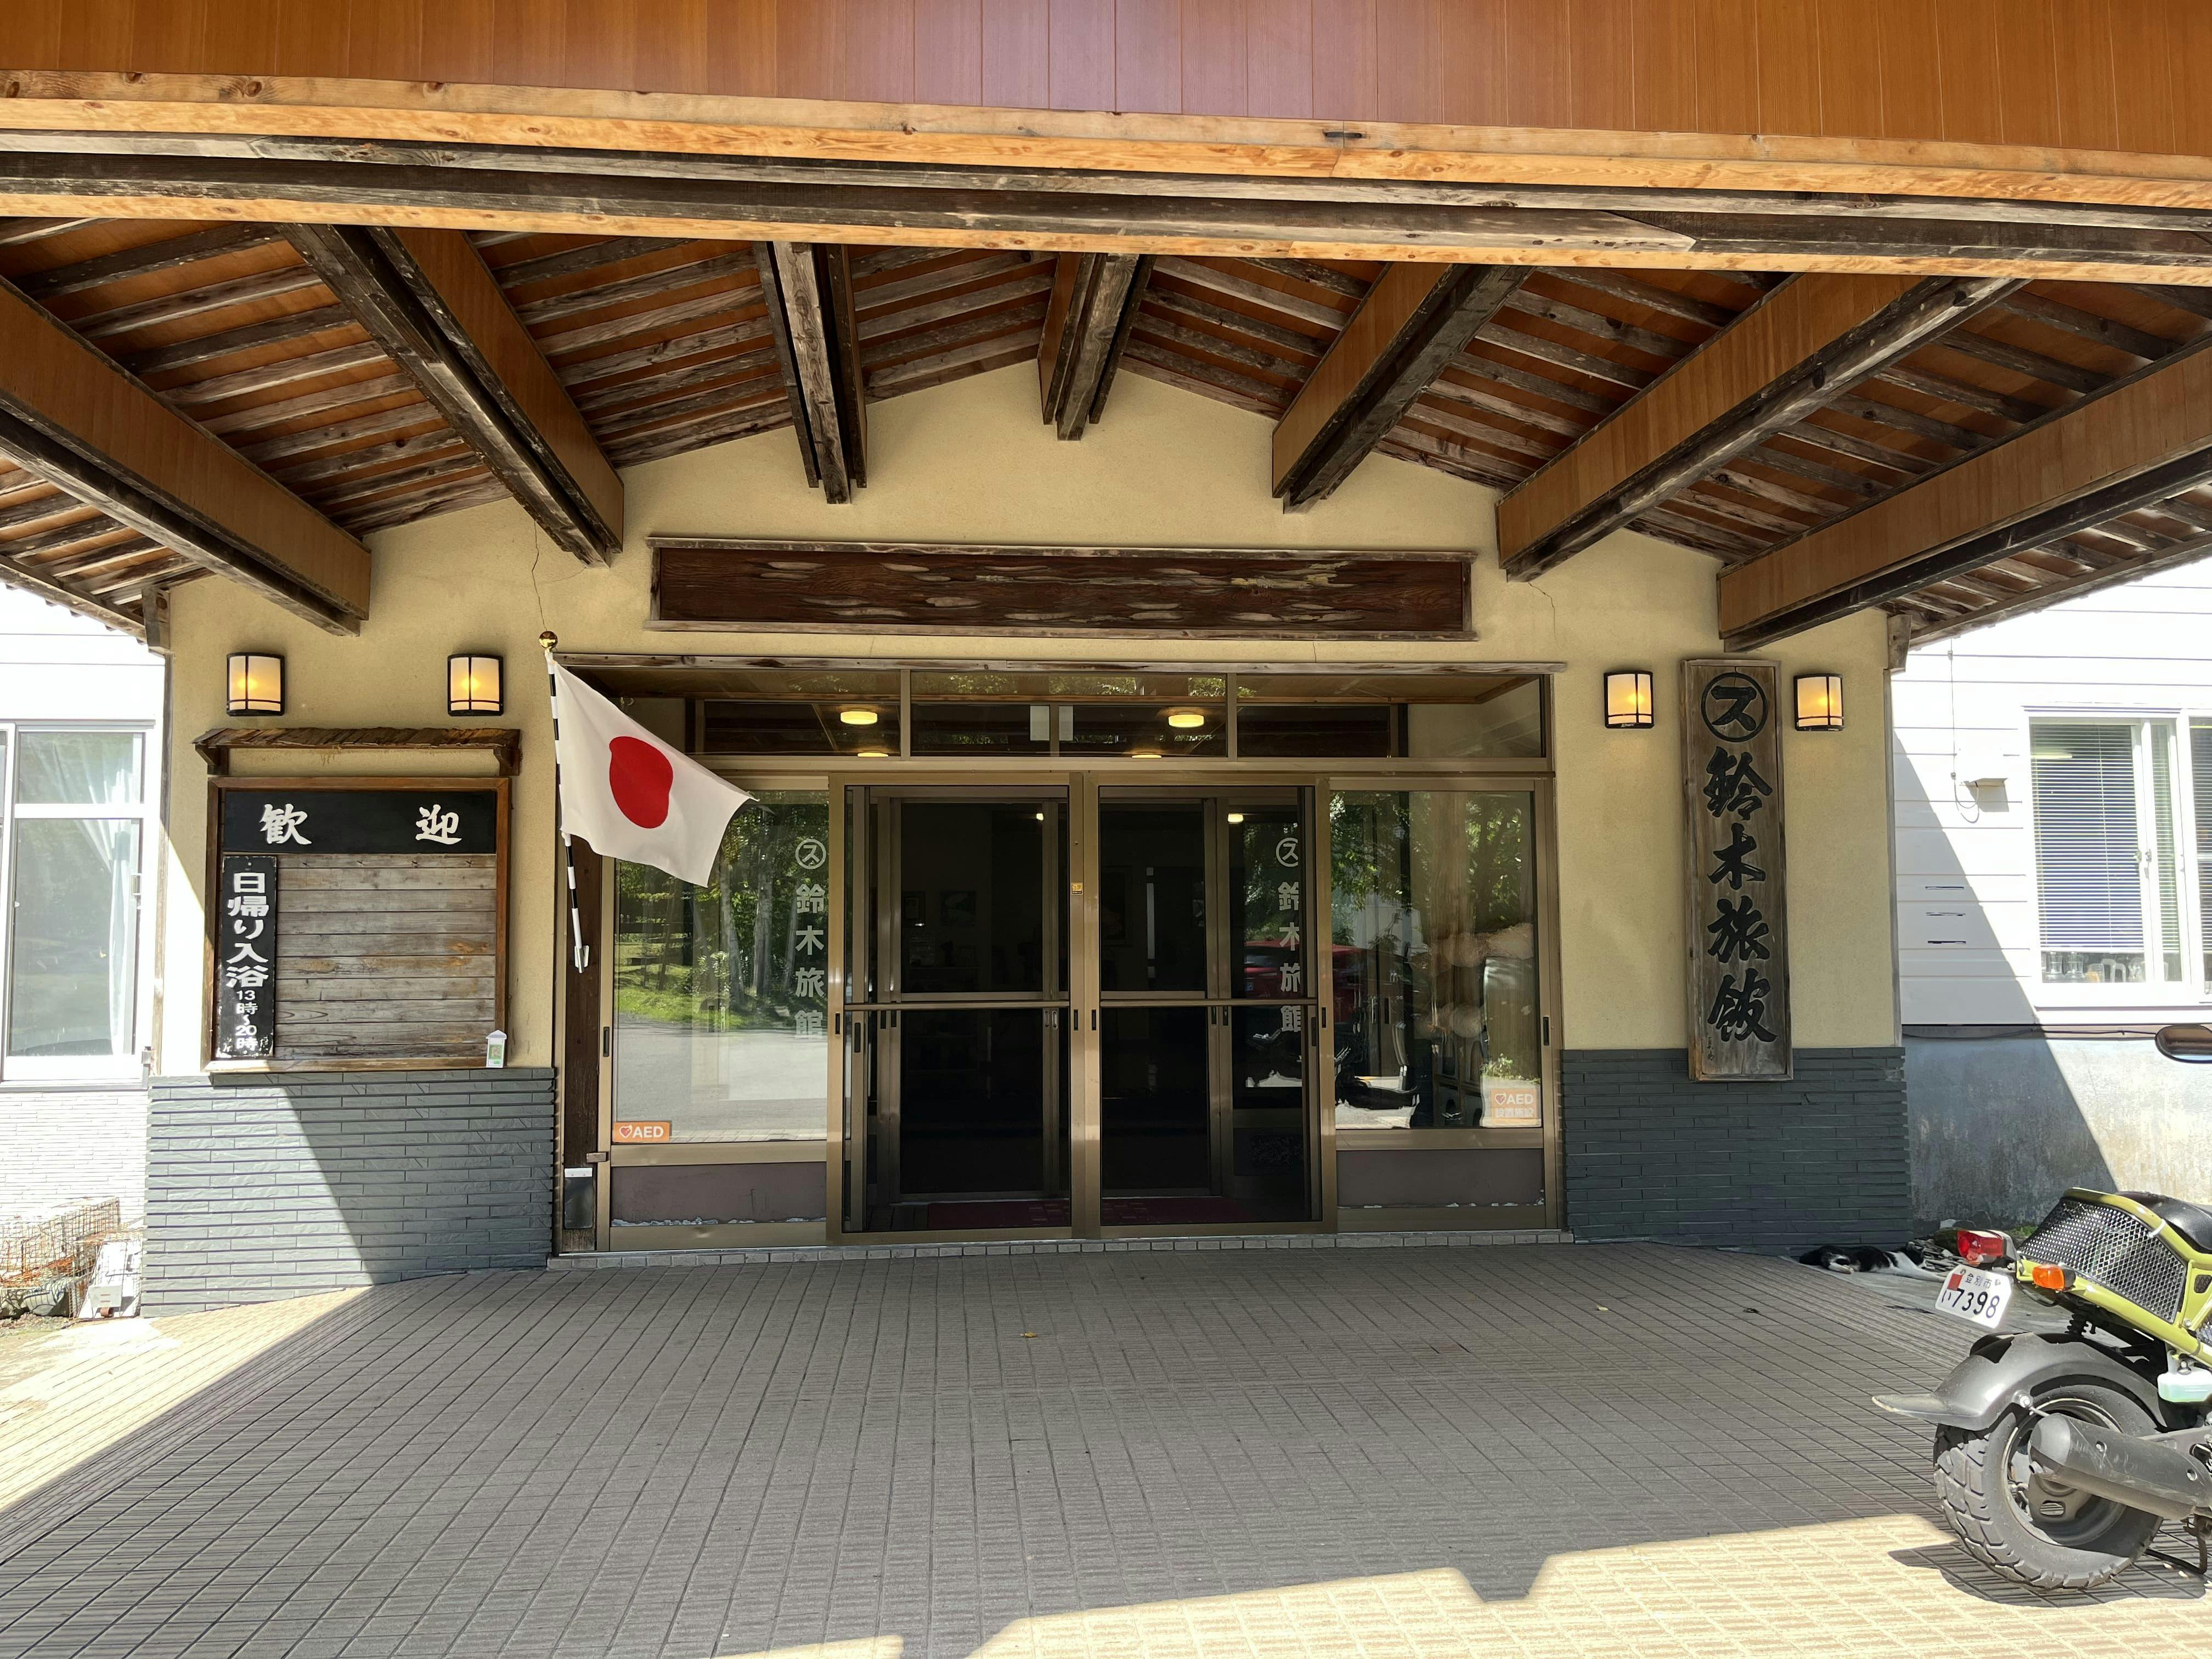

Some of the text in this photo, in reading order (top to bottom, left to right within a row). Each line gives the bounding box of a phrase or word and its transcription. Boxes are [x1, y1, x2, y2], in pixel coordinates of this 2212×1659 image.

[259, 803, 462, 845] 歓迎
[225, 872, 269, 988] 日帰り入浴
[794, 883, 825, 1035] 鈴木旅館
[1506, 1093, 1534, 1105] AED
[632, 1126, 664, 1138] AED
[1951, 1287, 2000, 1319] 7398
